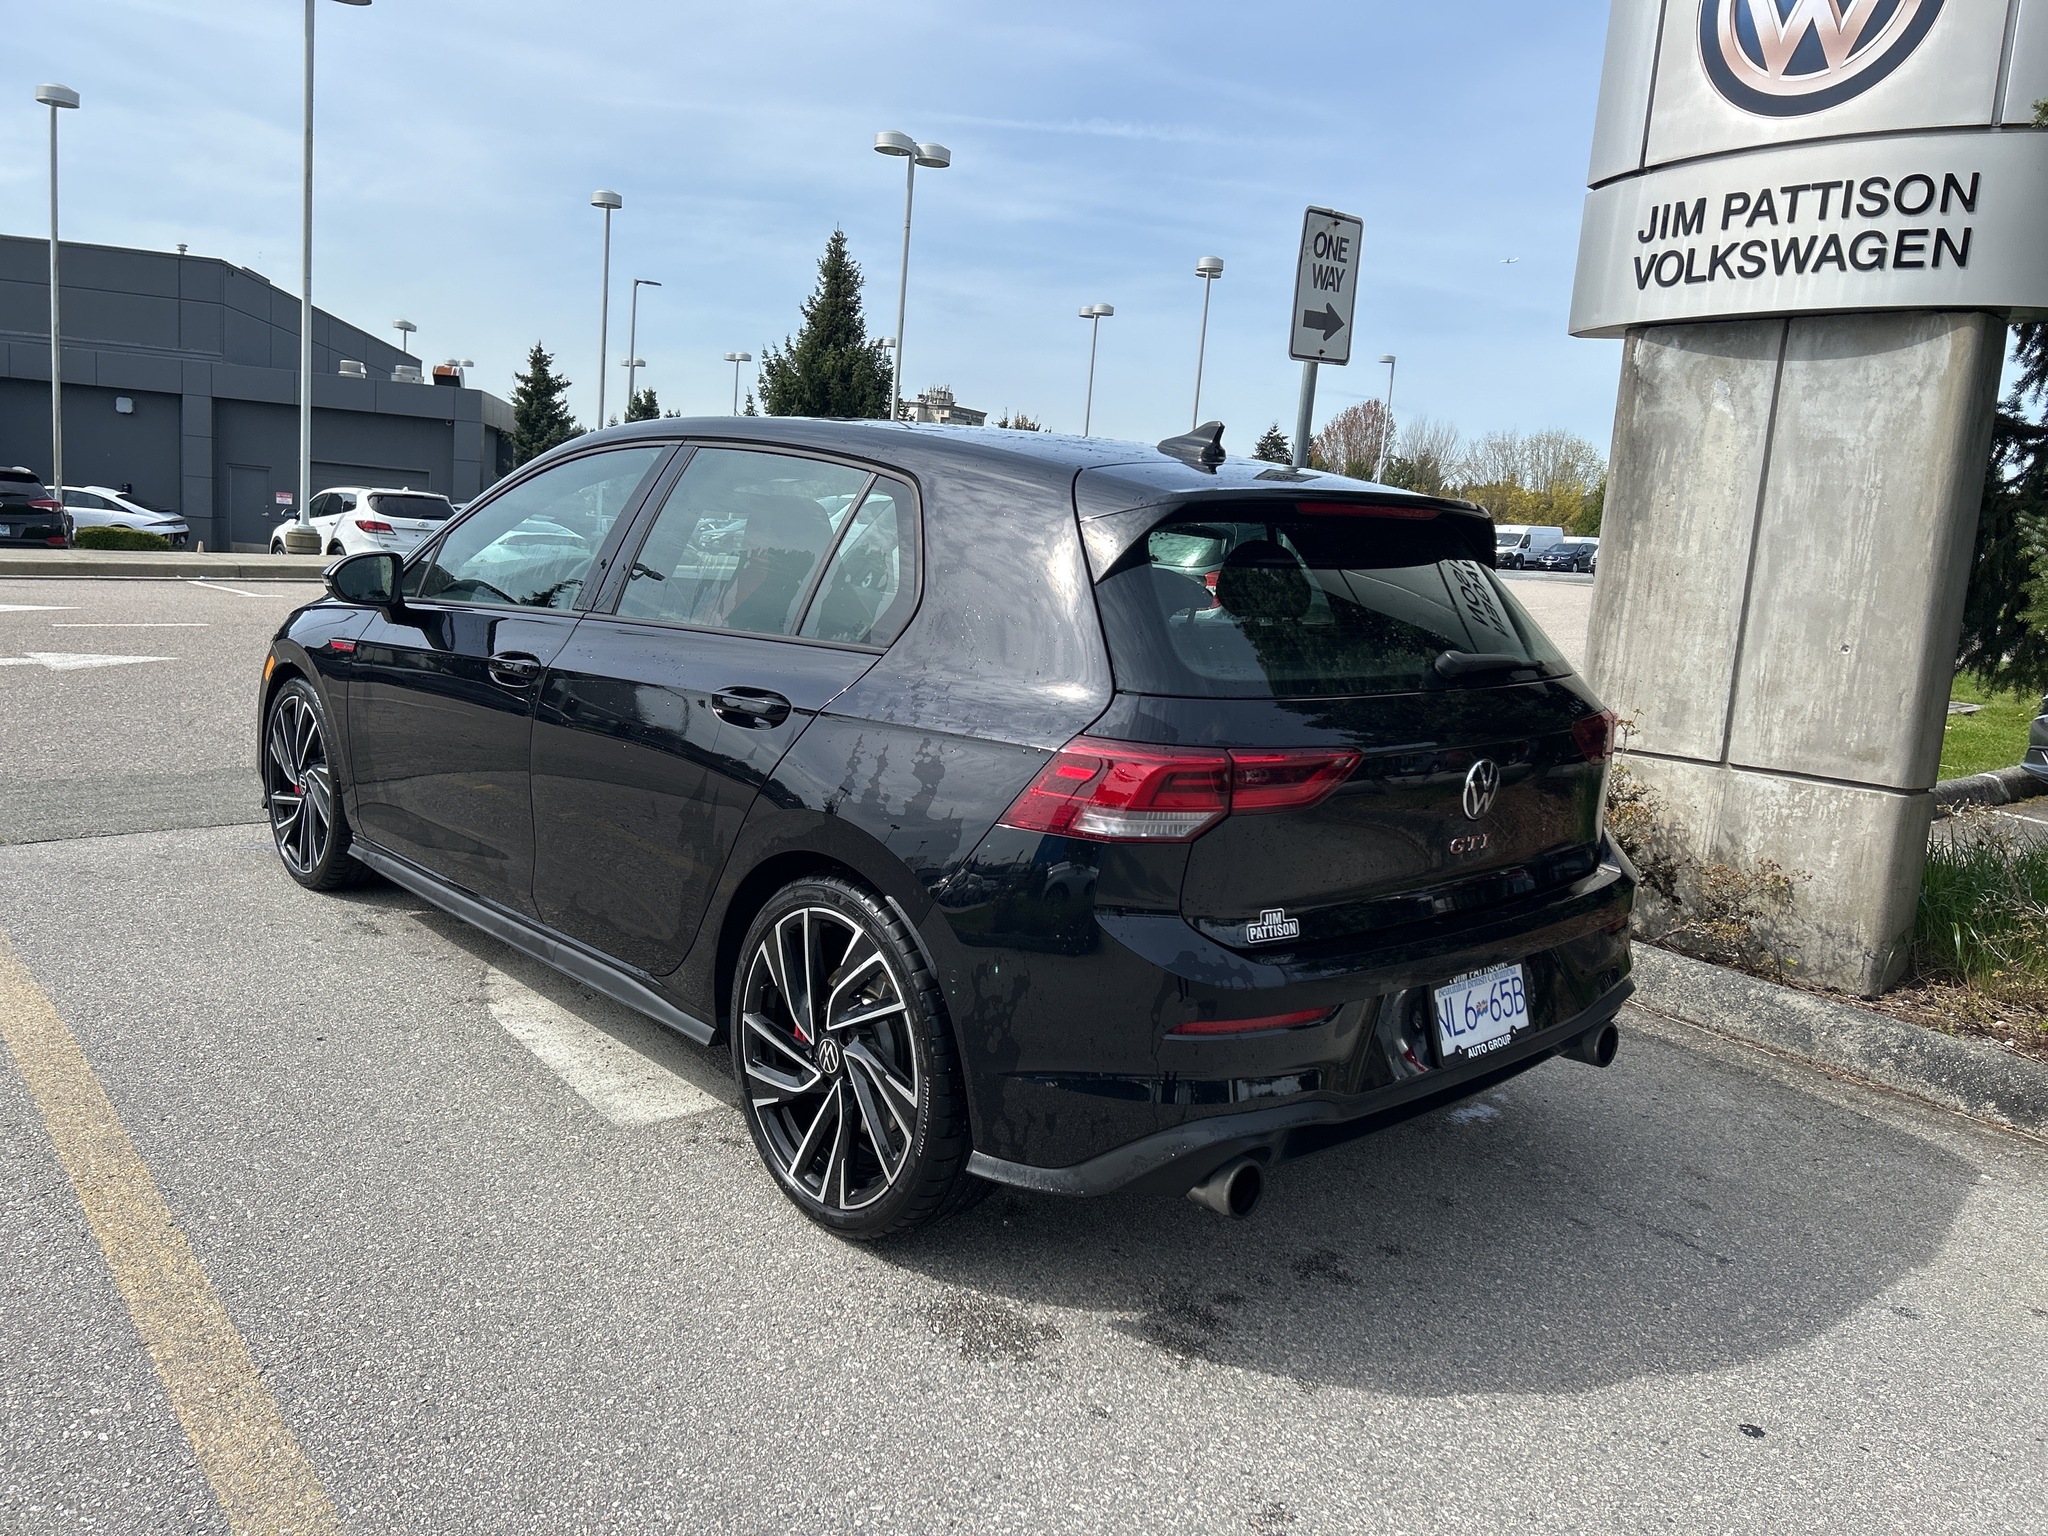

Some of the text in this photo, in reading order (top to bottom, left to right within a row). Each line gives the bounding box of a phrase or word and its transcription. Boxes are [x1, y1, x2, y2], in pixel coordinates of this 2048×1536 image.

[1637, 172, 1981, 244] JIM PATTISON
[1314, 232, 1349, 263] ONE
[1633, 227, 1973, 291] VOLKSWAGEN
[1313, 263, 1346, 292] WAY
[1449, 832, 1490, 856] GTI
[1249, 922, 1297, 940] PATTISON
[1263, 912, 1282, 926] JIM
[1467, 1033, 1512, 1059] AUTO GROUP
